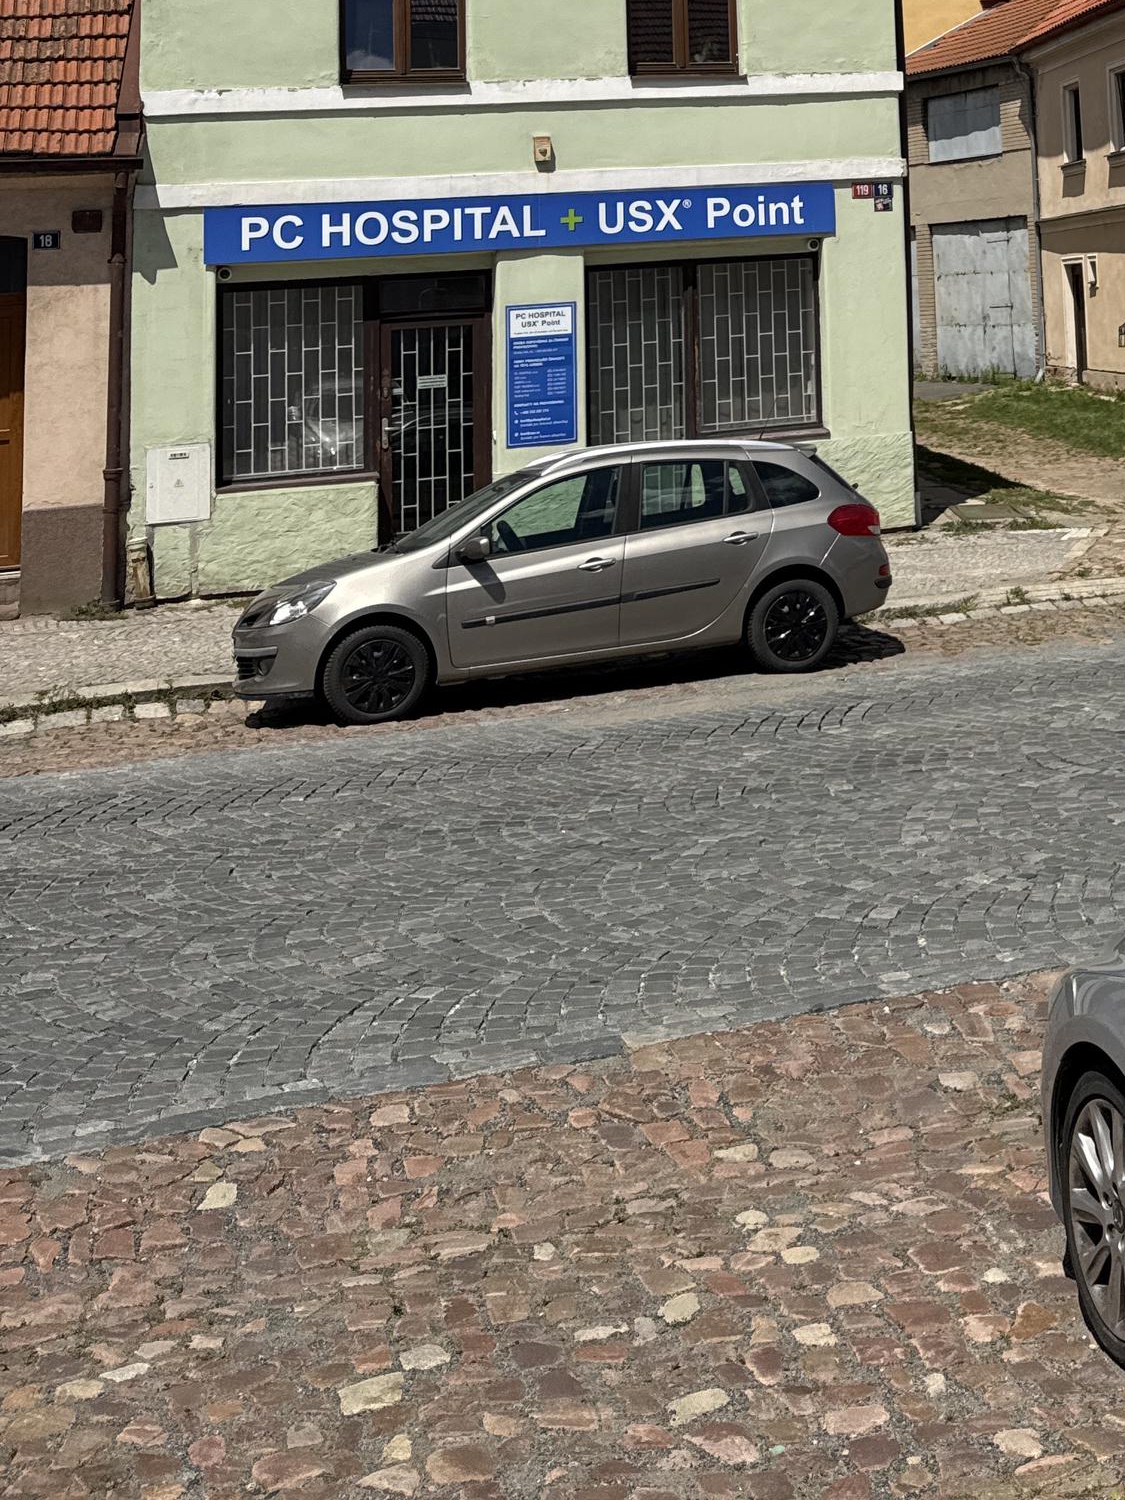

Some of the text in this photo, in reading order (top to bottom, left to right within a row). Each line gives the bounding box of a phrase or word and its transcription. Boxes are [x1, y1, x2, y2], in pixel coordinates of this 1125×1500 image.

[855, 184, 869, 196] 119
[877, 184, 888, 195] 16
[240, 214, 304, 251] PC
[320, 205, 546, 248] HOSPITAL
[706, 195, 805, 229] Point
[39, 234, 53, 247] 18
[528, 310, 566, 319] HOSPITAL
